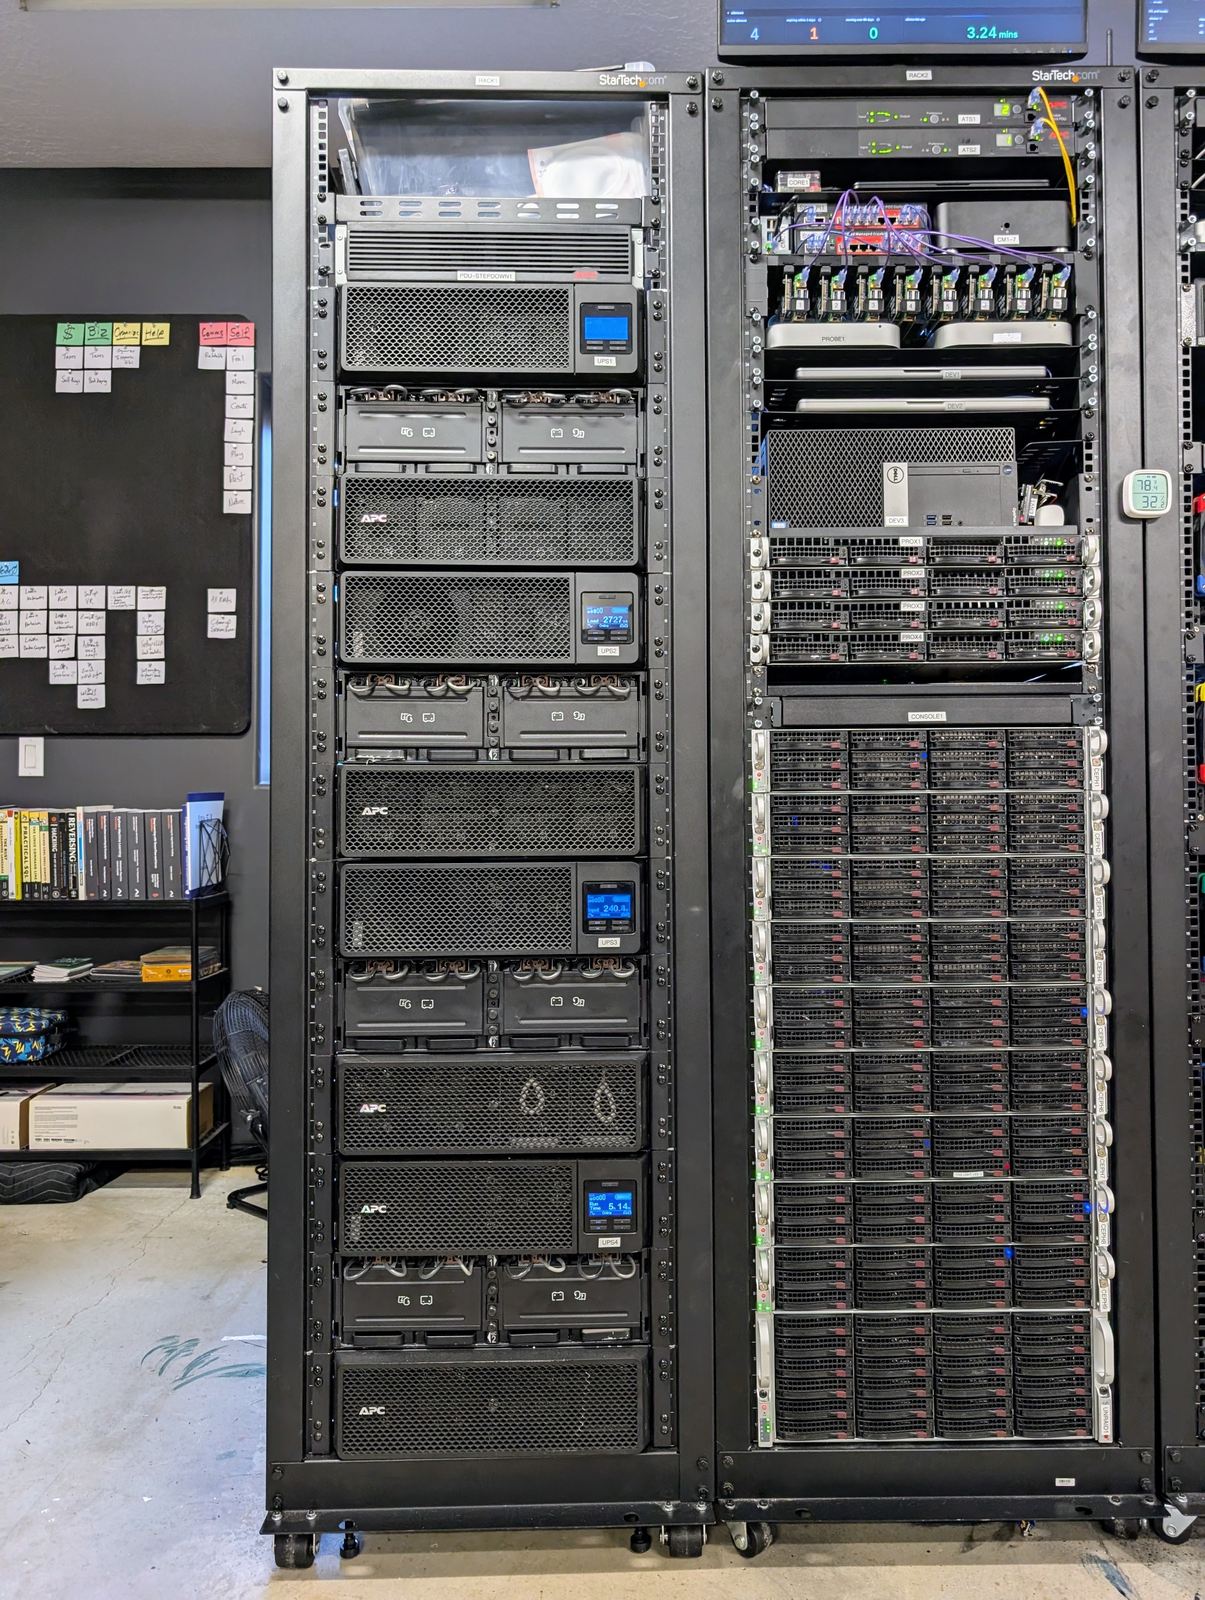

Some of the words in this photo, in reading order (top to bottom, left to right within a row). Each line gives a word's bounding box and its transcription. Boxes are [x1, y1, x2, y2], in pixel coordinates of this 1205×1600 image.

[750, 28, 760, 40] 4
[810, 27, 818, 40] 1
[869, 27, 878, 40] 0
[966, 26, 998, 39] 3.24
[999, 30, 1018, 39] mins
[63, 324, 75, 340] $
[88, 326, 108, 336] Biz
[145, 328, 164, 337] Help
[230, 326, 250, 337] Self
[360, 514, 387, 523] APC
[362, 806, 388, 815] APC
[360, 1104, 386, 1112] APC
[360, 1205, 387, 1214] APC
[359, 1407, 385, 1415] APC
